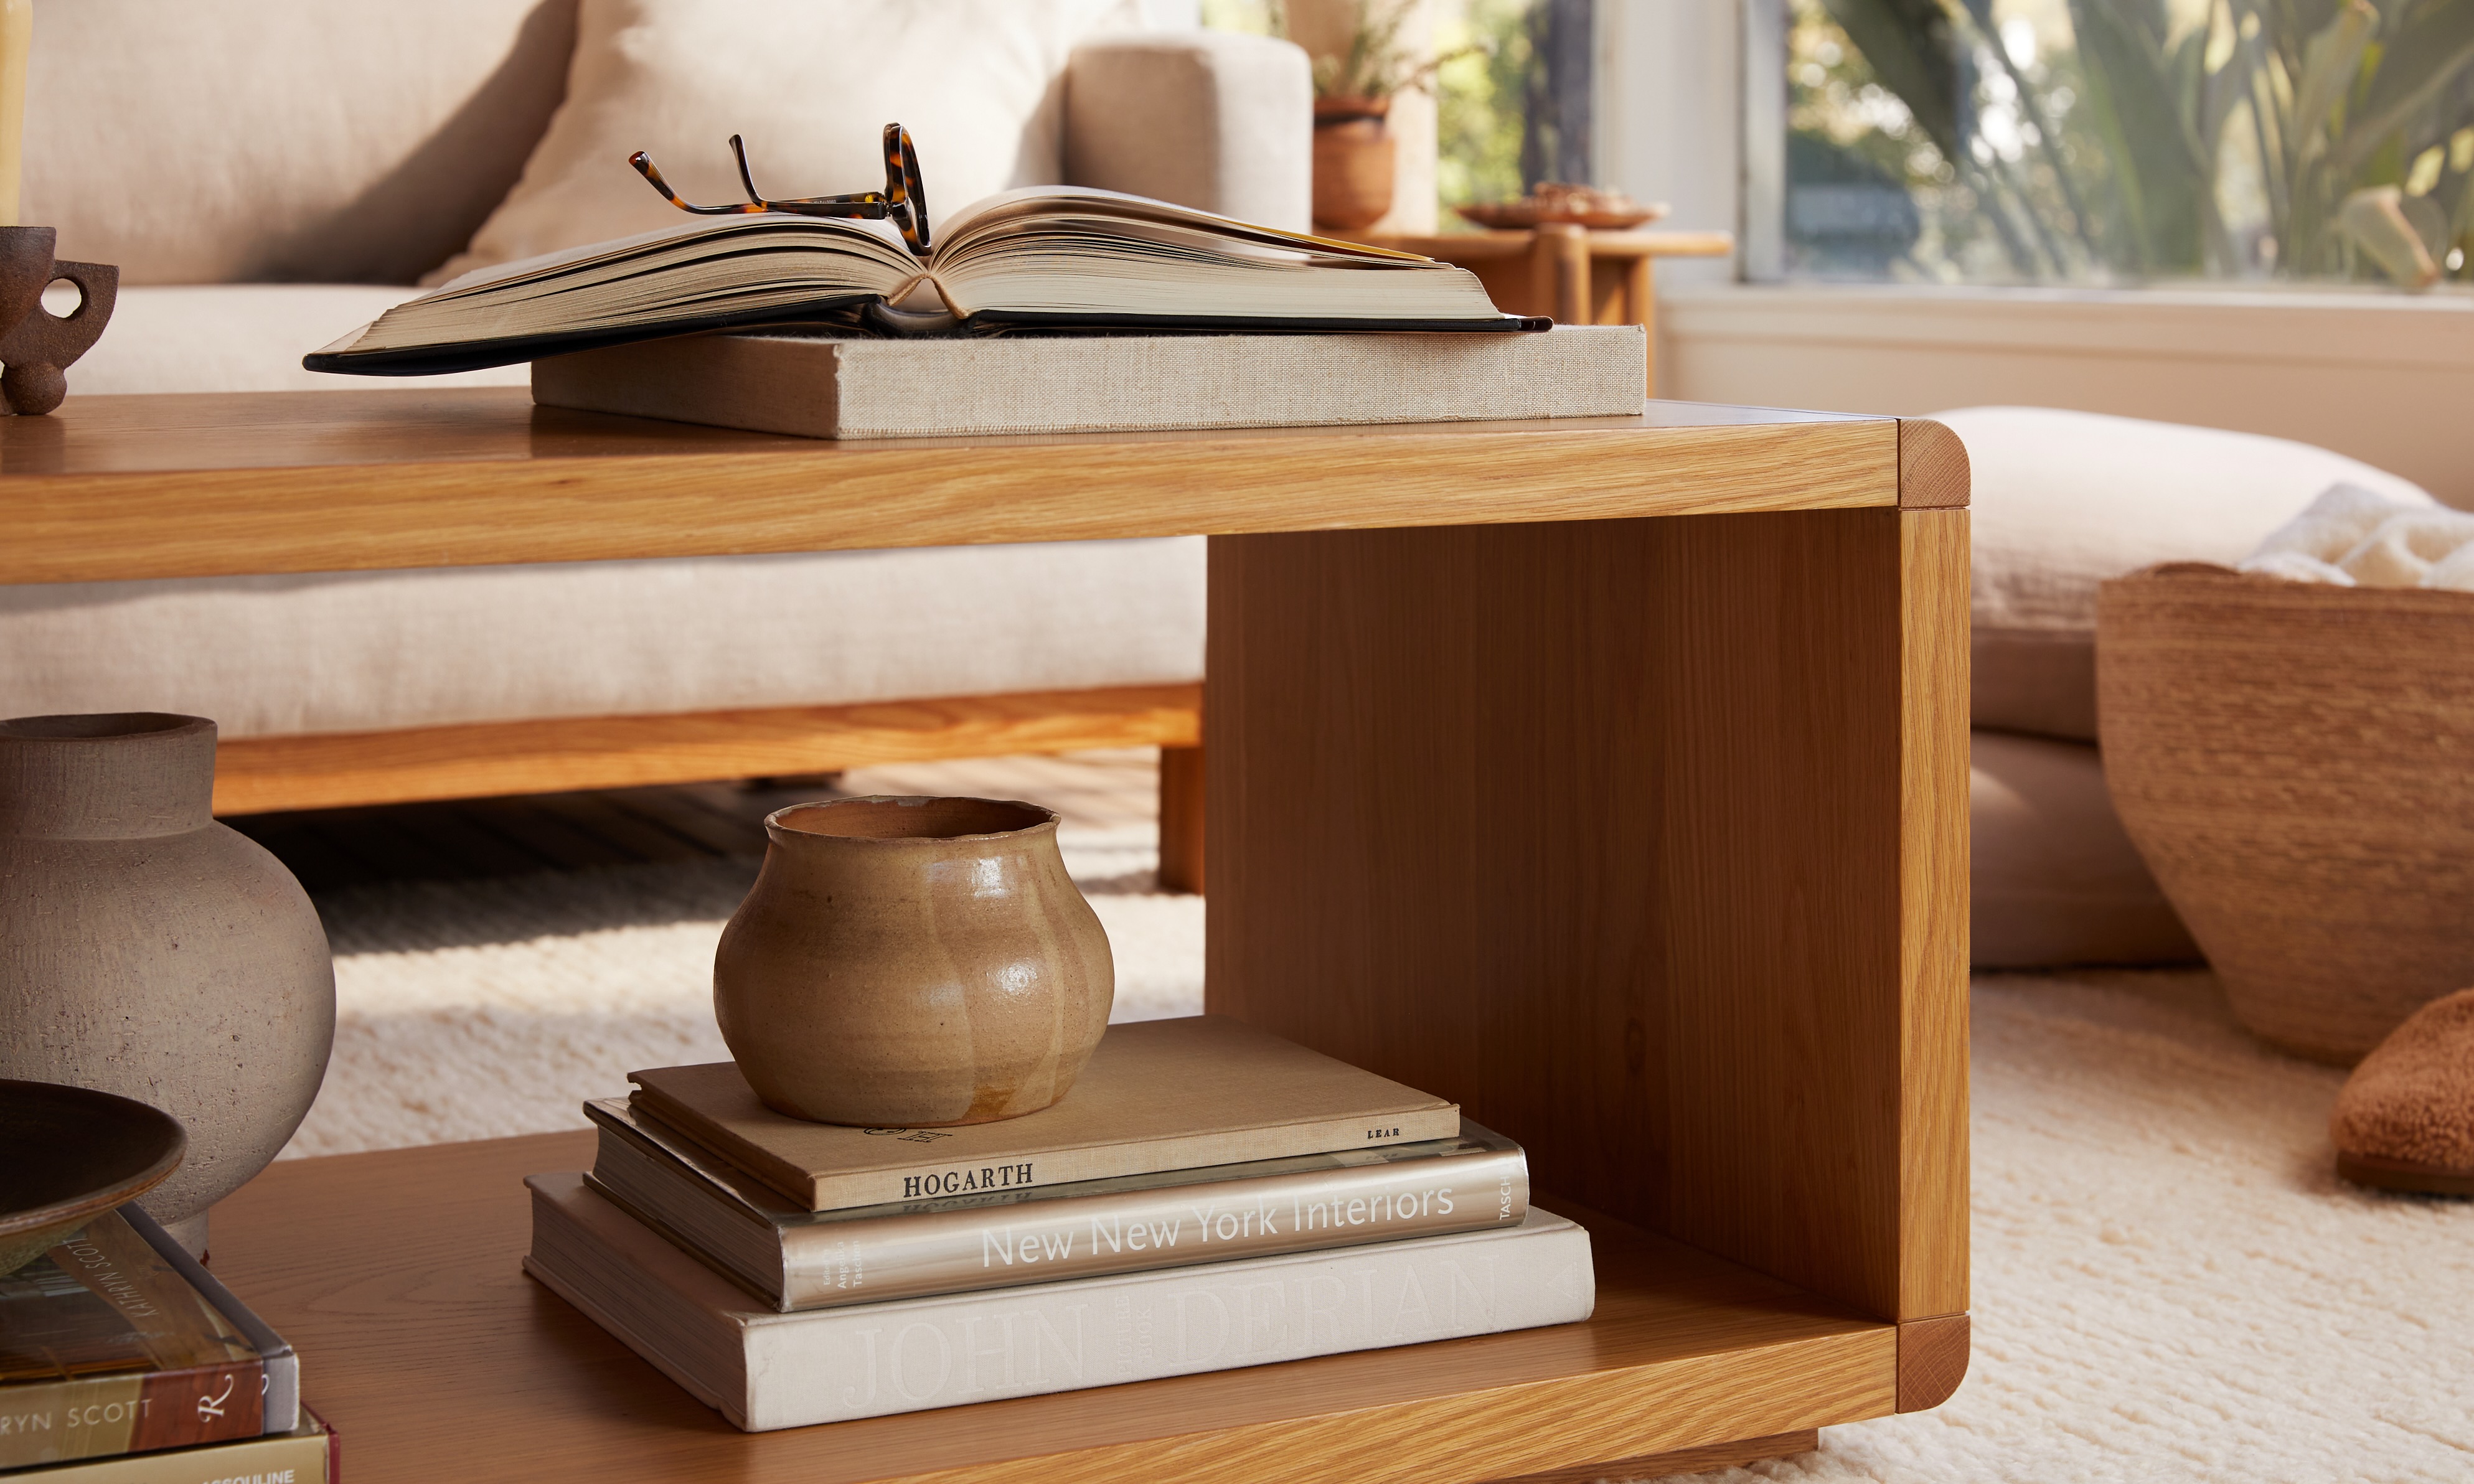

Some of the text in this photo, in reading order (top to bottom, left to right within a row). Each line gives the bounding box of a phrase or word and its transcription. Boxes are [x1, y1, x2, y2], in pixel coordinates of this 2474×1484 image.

[1367, 1127, 1400, 1140] LEAR
[903, 1163, 1033, 1198] HOGARTH
[1498, 1173, 1511, 1221] TASCH
[982, 1185, 1454, 1268] New New York Interiors
[835, 1241, 849, 1289] Angelika
[852, 1241, 862, 1288] Taschen
[93, 1271, 159, 1318] KATHRYN
[842, 1254, 1500, 1409] JOHN DERIAN
[1137, 1306, 1153, 1360] BOOK
[67, 1398, 153, 1429] SCOTT
[202, 1469, 295, 1484] OULINE
